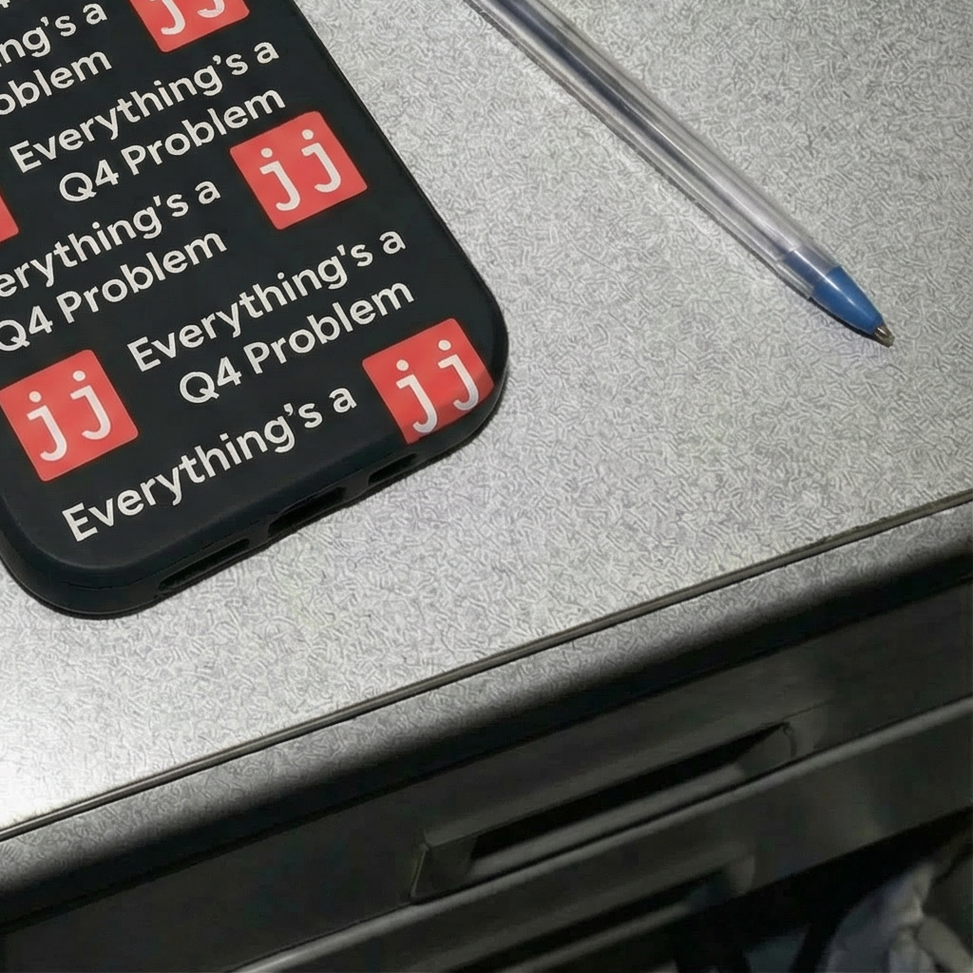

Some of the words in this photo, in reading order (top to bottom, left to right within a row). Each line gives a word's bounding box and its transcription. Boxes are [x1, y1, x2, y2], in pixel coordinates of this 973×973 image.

[83, 1, 108, 25] a
[9, 55, 249, 174] Everything's
[254, 40, 280, 64] a
[58, 161, 120, 204] Q4
[124, 85, 287, 177] Problem
[195, 179, 223, 203] a
[58, 229, 228, 320] Problem
[127, 245, 375, 372] Everything's
[379, 230, 407, 255] a
[178, 357, 243, 404] Q4
[248, 280, 416, 376] Problem
[62, 403, 324, 543] Everything's
[329, 387, 358, 412] a
